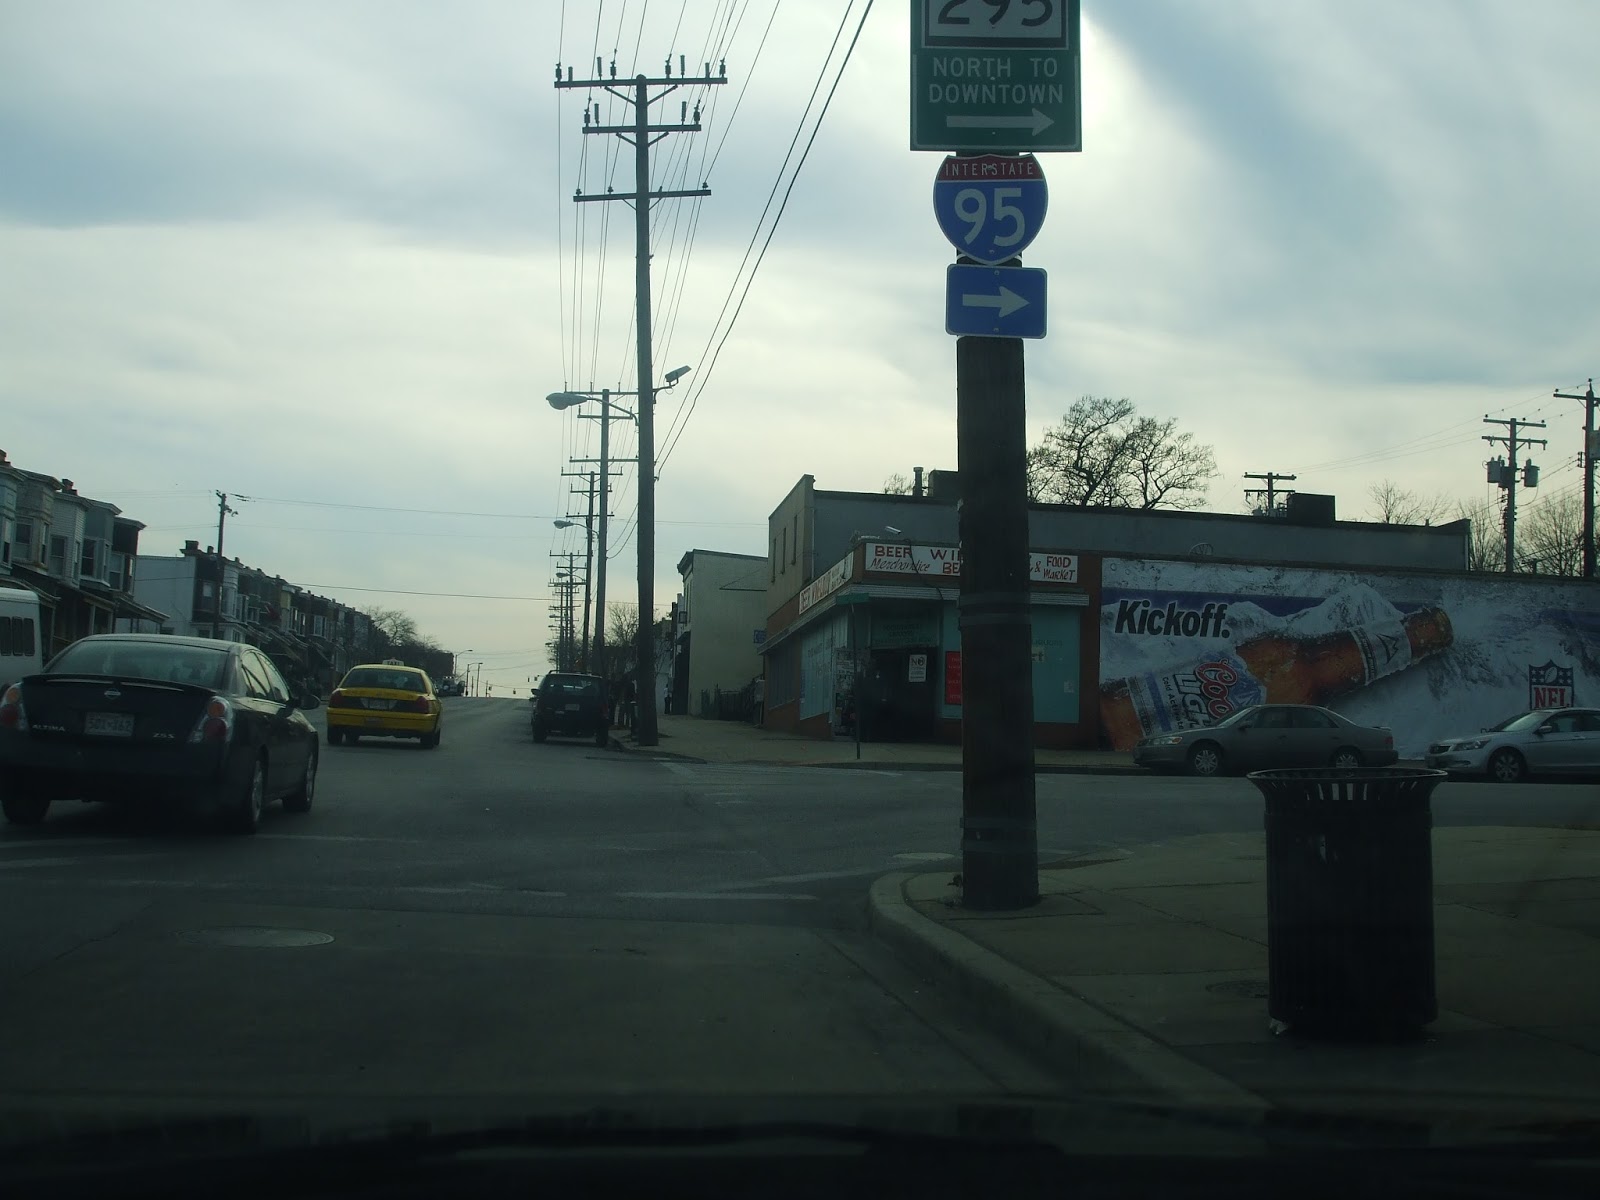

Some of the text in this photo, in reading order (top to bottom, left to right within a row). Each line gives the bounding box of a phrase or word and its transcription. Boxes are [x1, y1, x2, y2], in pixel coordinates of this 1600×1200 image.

[932, 57, 1058, 77] NORTH TO
[928, 83, 1063, 104] DOWNTOWN
[945, 162, 1034, 176] INTERSTATE
[954, 187, 1026, 247] 95
[874, 545, 1072, 568] BEER WI FOOD
[1114, 599, 1231, 639] Kickoff.
[1534, 686, 1570, 709] NFL
